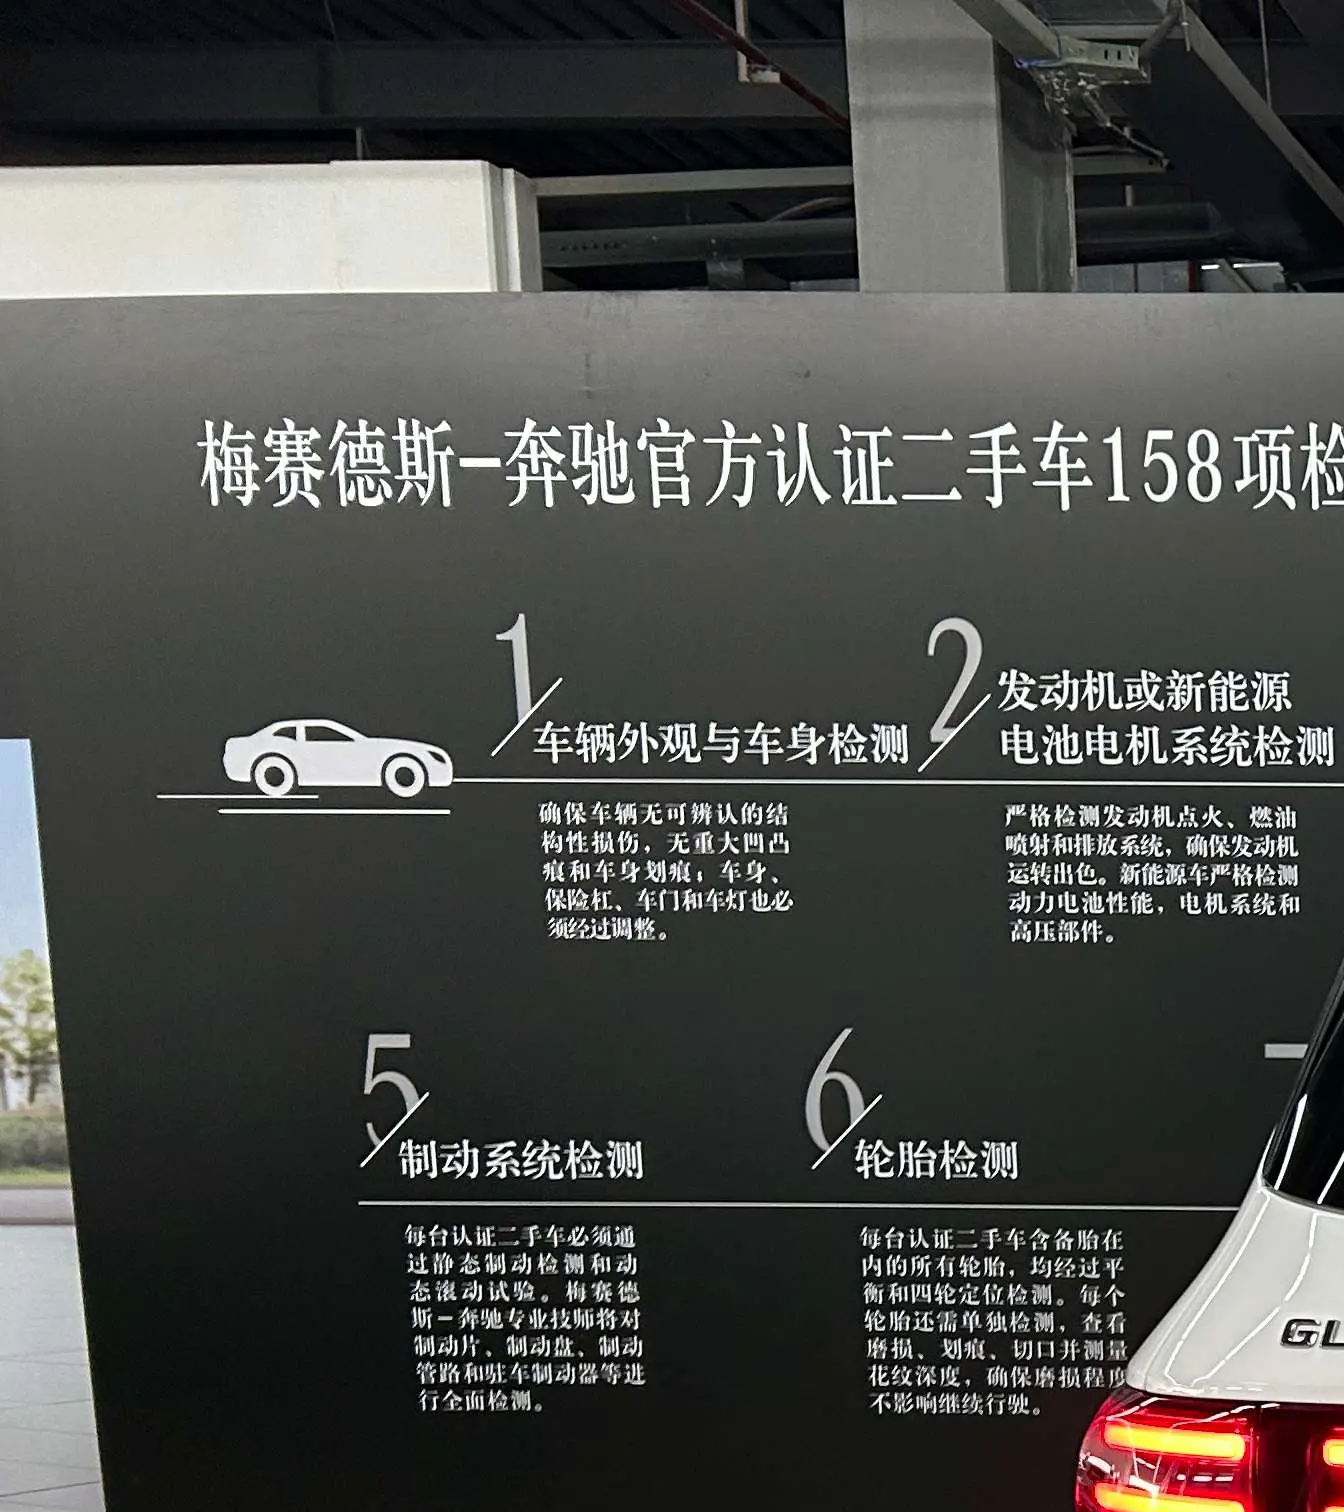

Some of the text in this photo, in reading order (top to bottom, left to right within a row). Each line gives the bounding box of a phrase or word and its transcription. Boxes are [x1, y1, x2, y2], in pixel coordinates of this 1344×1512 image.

[496, 613, 532, 724] 1
[927, 617, 983, 744] 2
[998, 669, 1292, 712] 发动机或新能源
[534, 721, 908, 765] 车辆外观与车身检测
[1001, 724, 1334, 767] 电池电机系统检测
[547, 917, 666, 940] 须经过调整。
[1011, 919, 1113, 943] 高压部件。
[364, 1033, 421, 1146] 5
[805, 1027, 866, 1152] 6
[399, 1139, 643, 1179] 制动系统检测
[855, 1139, 1017, 1180] 轮胎检测
[420, 1389, 542, 1411] 行全面检测。
[871, 1392, 1040, 1415] 不影响继续行驶。
